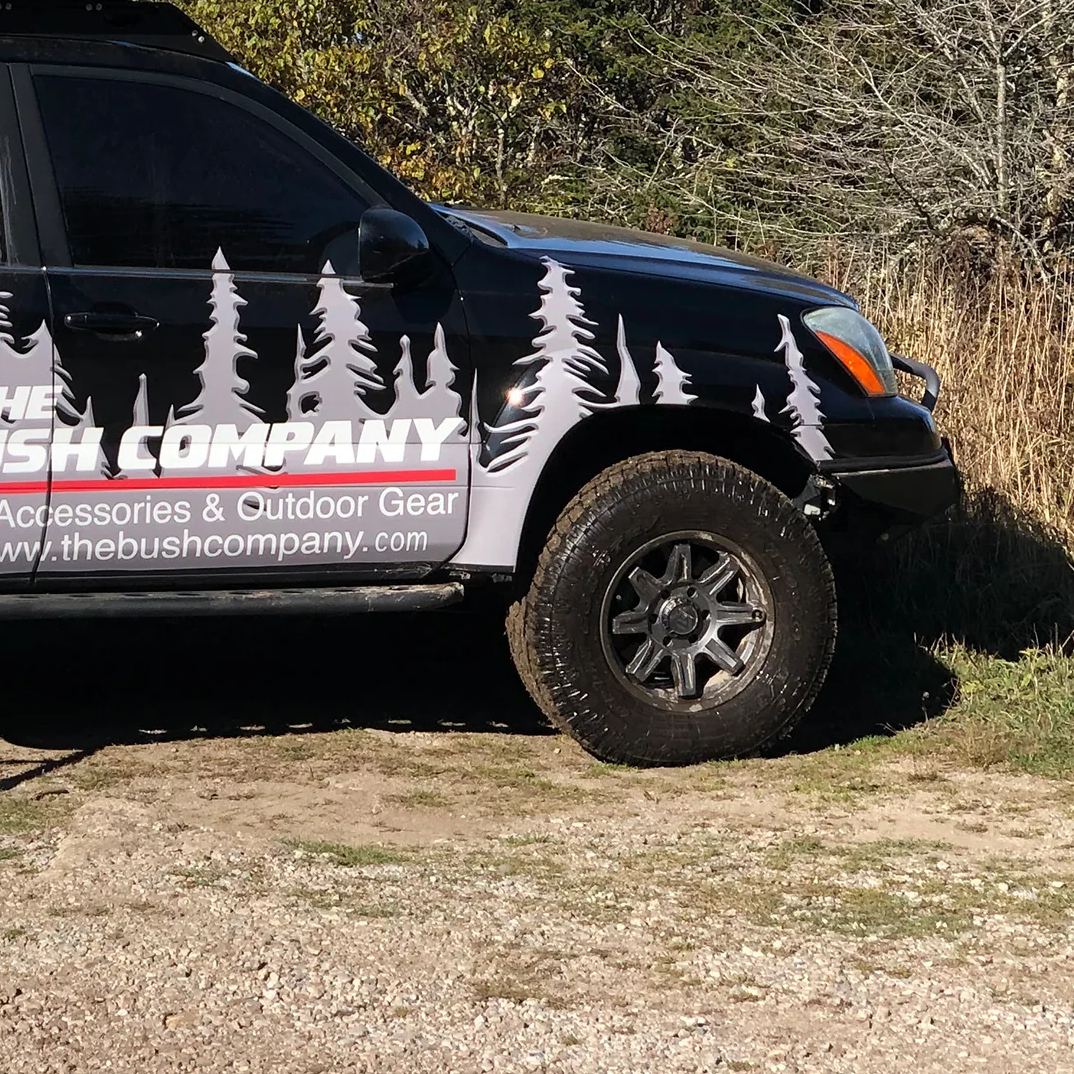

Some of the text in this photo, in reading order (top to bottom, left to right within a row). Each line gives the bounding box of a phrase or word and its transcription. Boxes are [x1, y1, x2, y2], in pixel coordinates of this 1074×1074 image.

[116, 417, 465, 471] COMPANY
[201, 492, 226, 523] &
[236, 490, 369, 522] Outdoor
[378, 486, 459, 517] Gear
